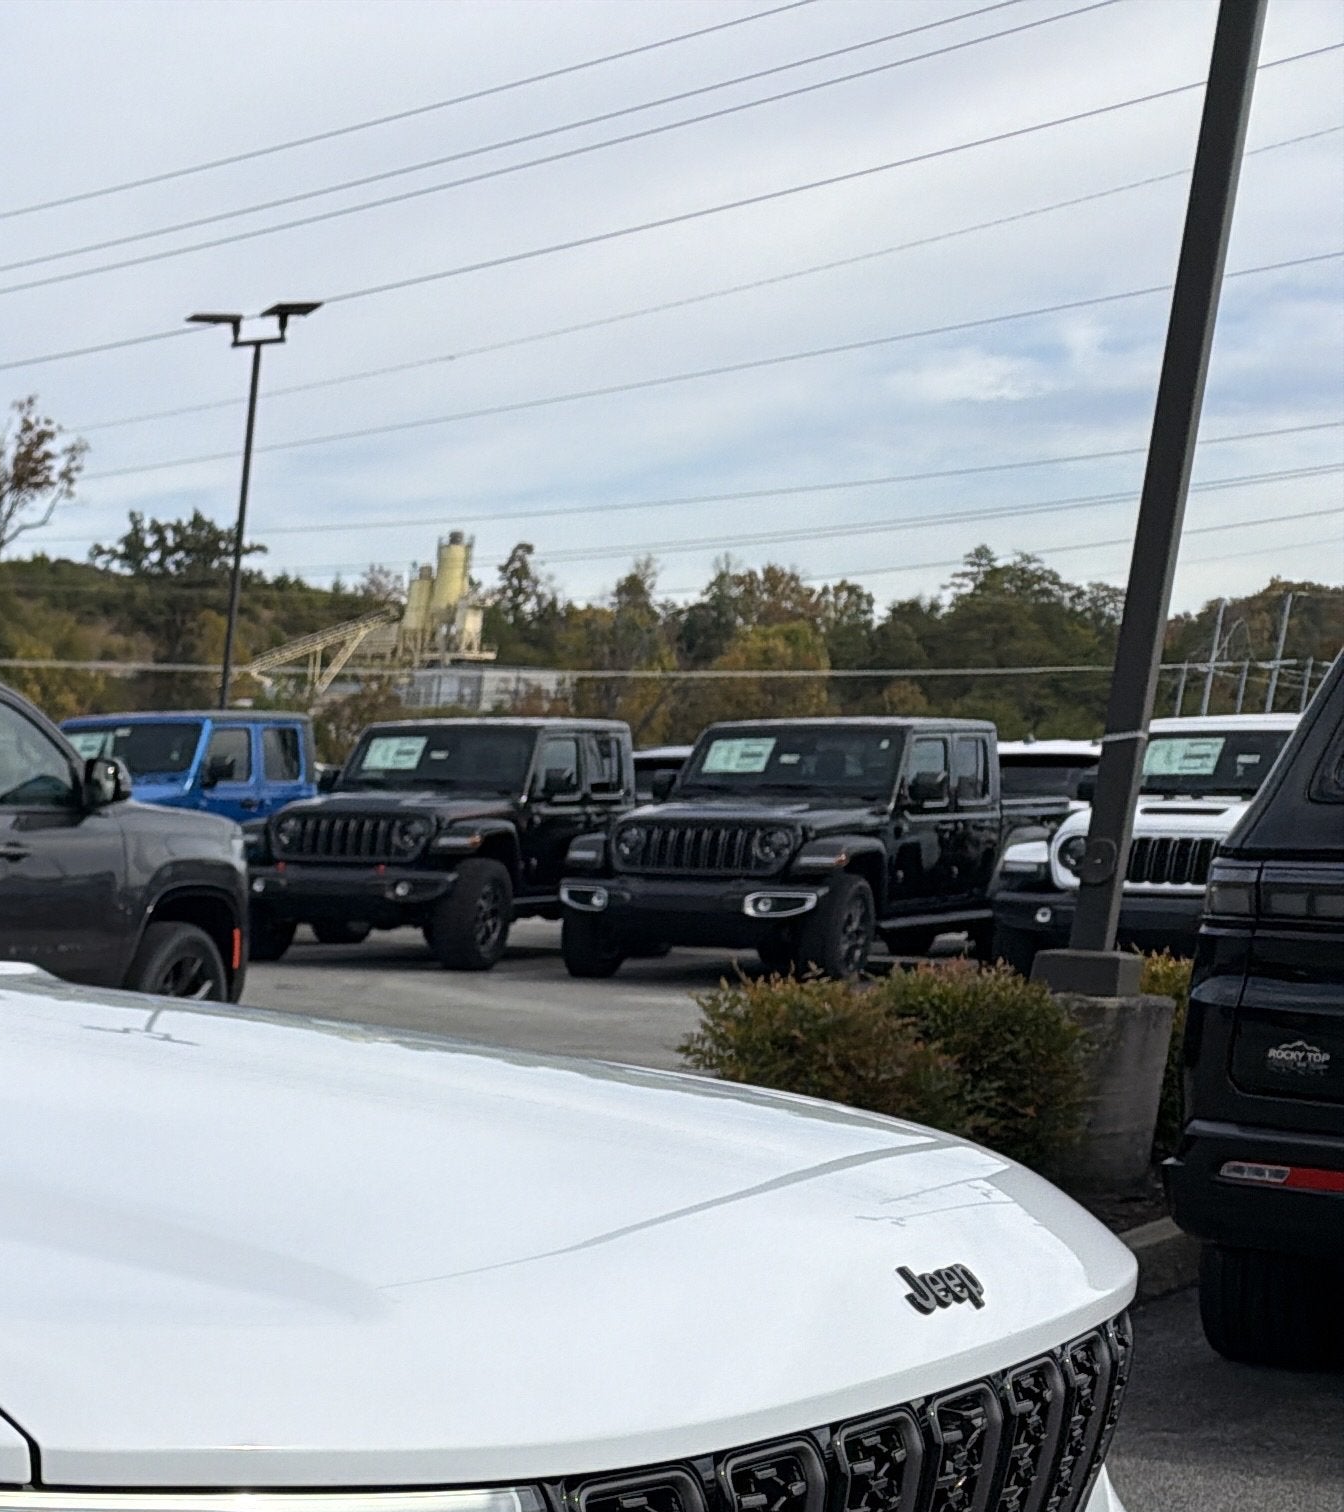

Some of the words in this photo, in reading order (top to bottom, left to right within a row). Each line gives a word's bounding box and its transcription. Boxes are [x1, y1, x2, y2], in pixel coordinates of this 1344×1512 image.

[1268, 1048, 1305, 1061] ROCKY
[1307, 1052, 1330, 1062] TOP
[895, 1263, 985, 1315] Jeep
